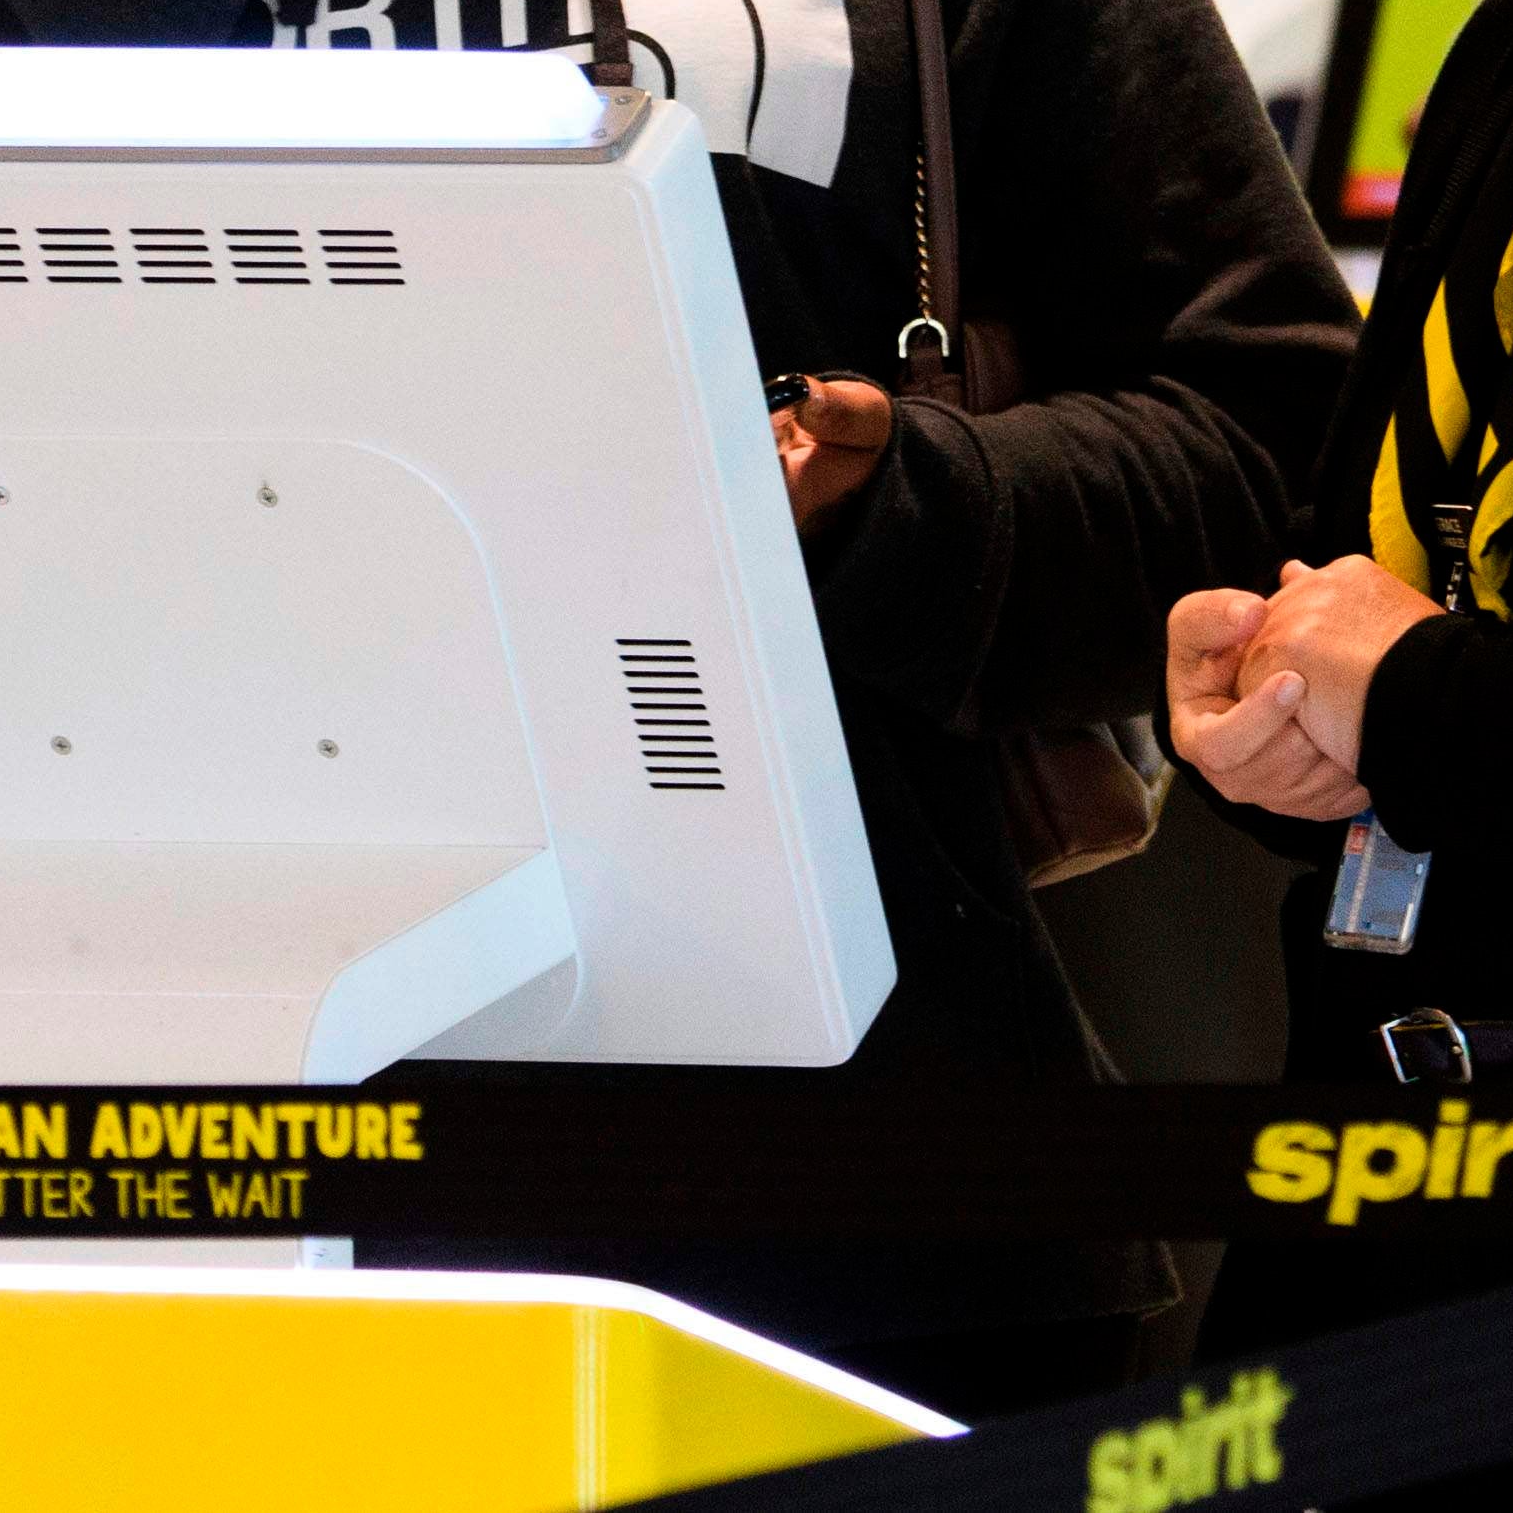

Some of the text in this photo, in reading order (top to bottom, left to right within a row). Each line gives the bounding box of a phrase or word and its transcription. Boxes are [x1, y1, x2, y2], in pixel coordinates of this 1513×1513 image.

[89, 1102, 425, 1161] ADVENTURE
[108, 1170, 193, 1220] THE
[207, 1171, 310, 1219] WAIT
[1085, 1367, 1289, 1513] spirit
